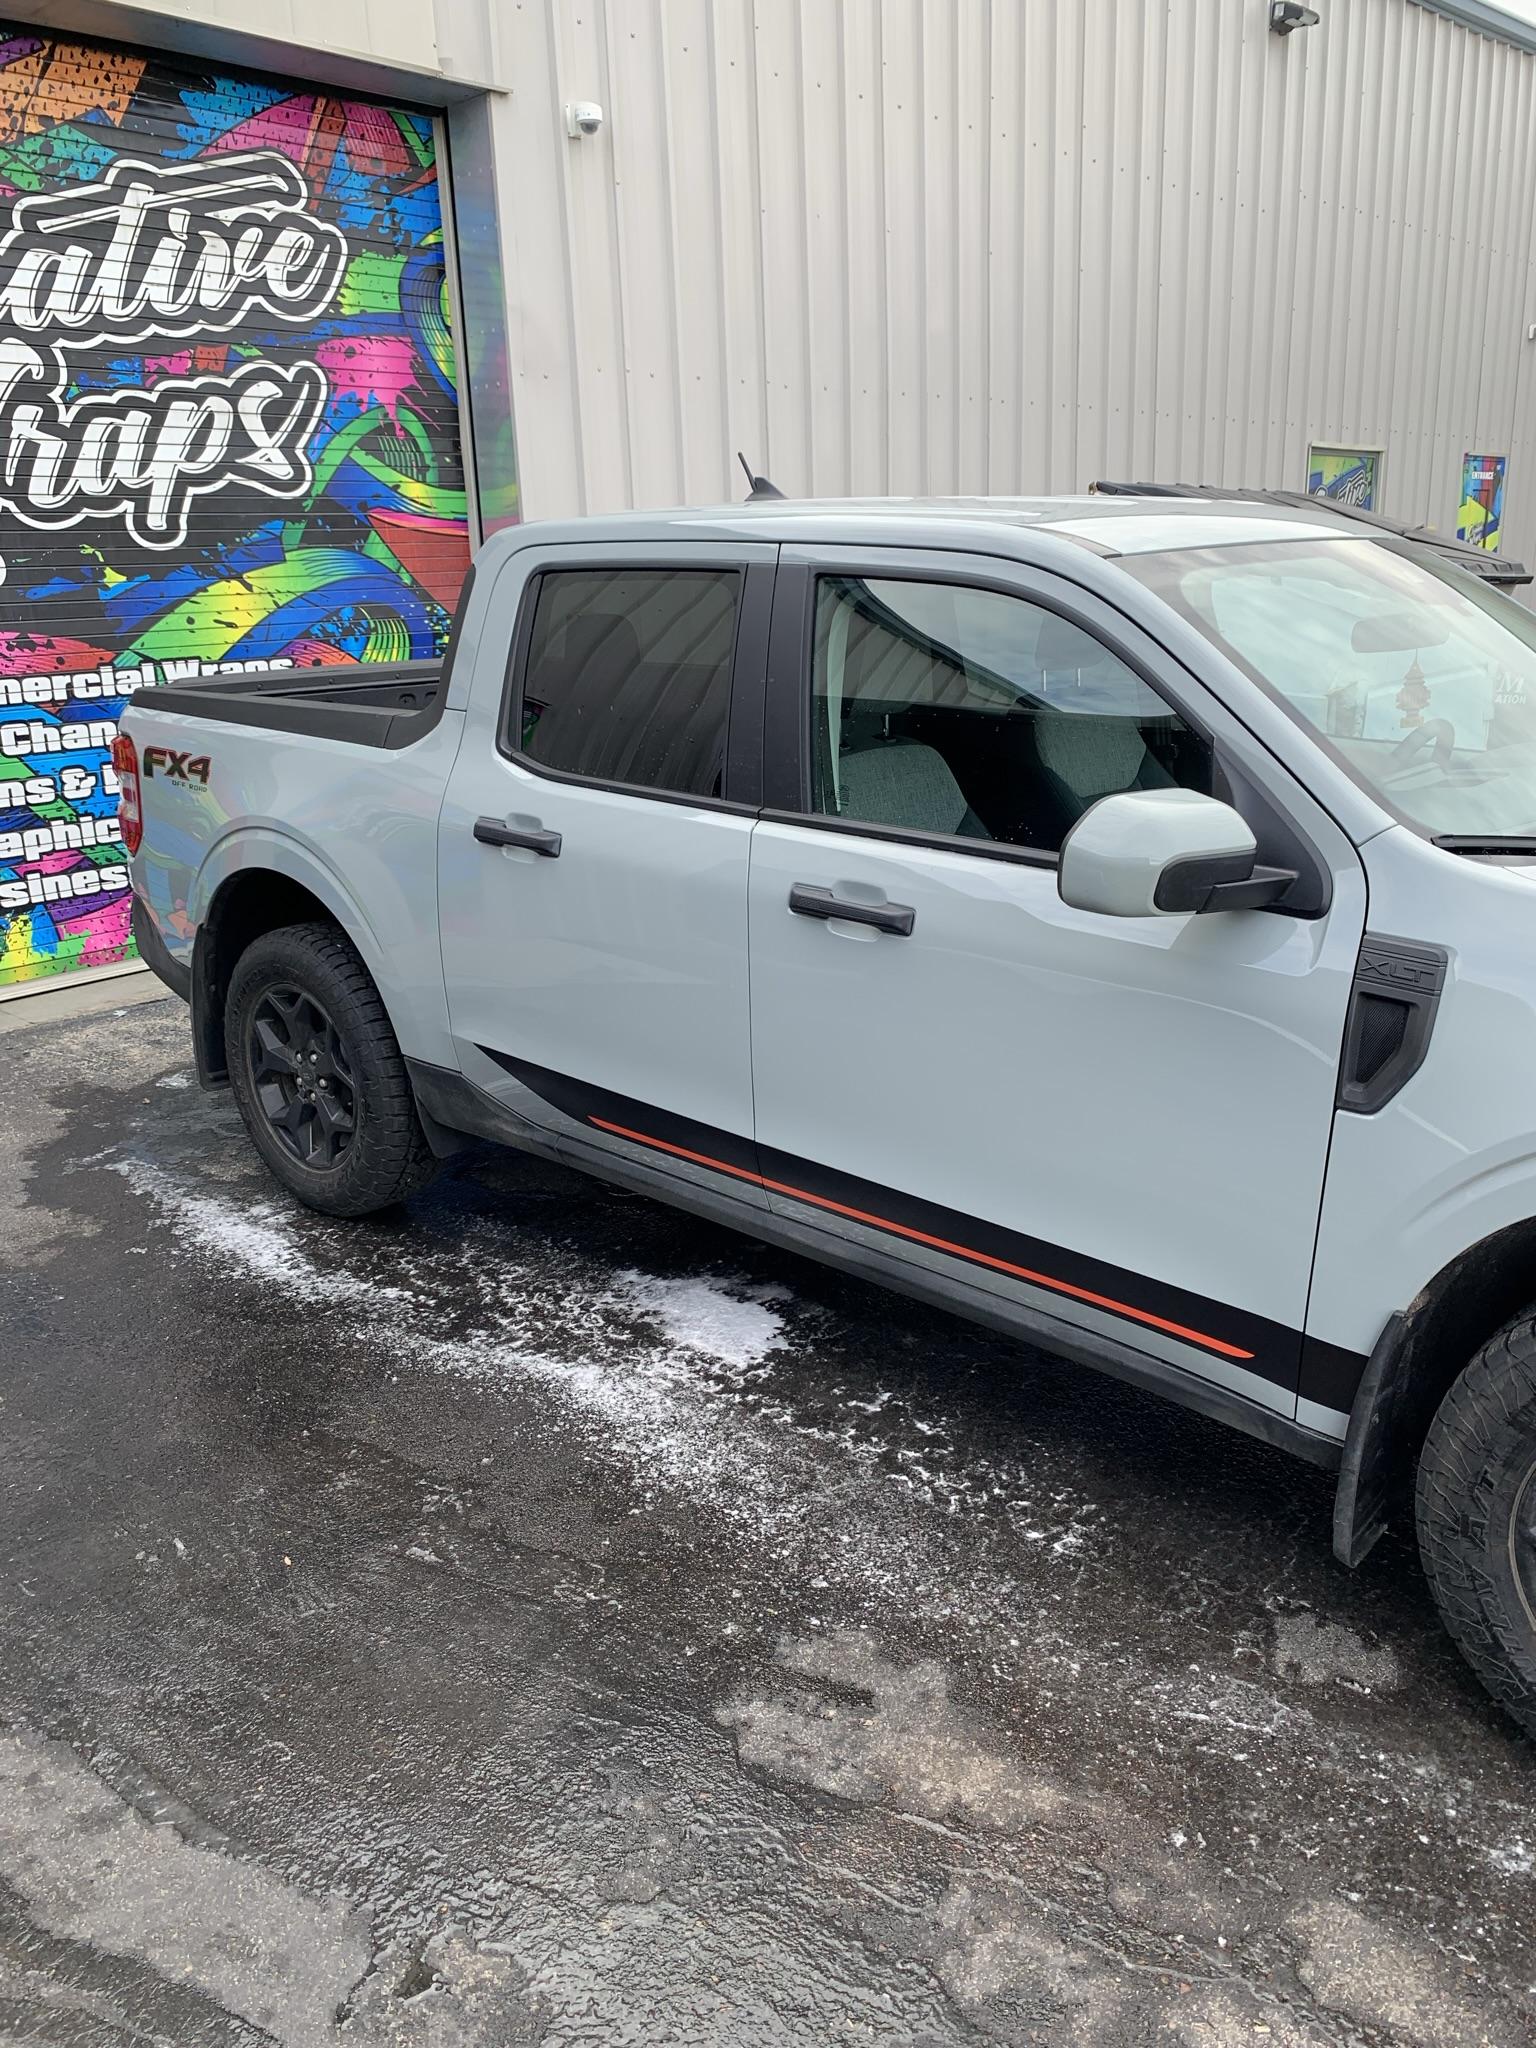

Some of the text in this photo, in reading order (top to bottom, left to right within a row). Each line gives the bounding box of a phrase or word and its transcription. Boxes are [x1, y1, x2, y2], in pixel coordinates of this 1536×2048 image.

[0, 173, 330, 331] ative
[0, 338, 311, 531] raps
[1471, 471, 1495, 480] ENTRANCE
[143, 745, 212, 785] FX4
[61, 768, 97, 800] &
[171, 779, 208, 793] OFF ROAD
[1360, 957, 1435, 984] XLT
